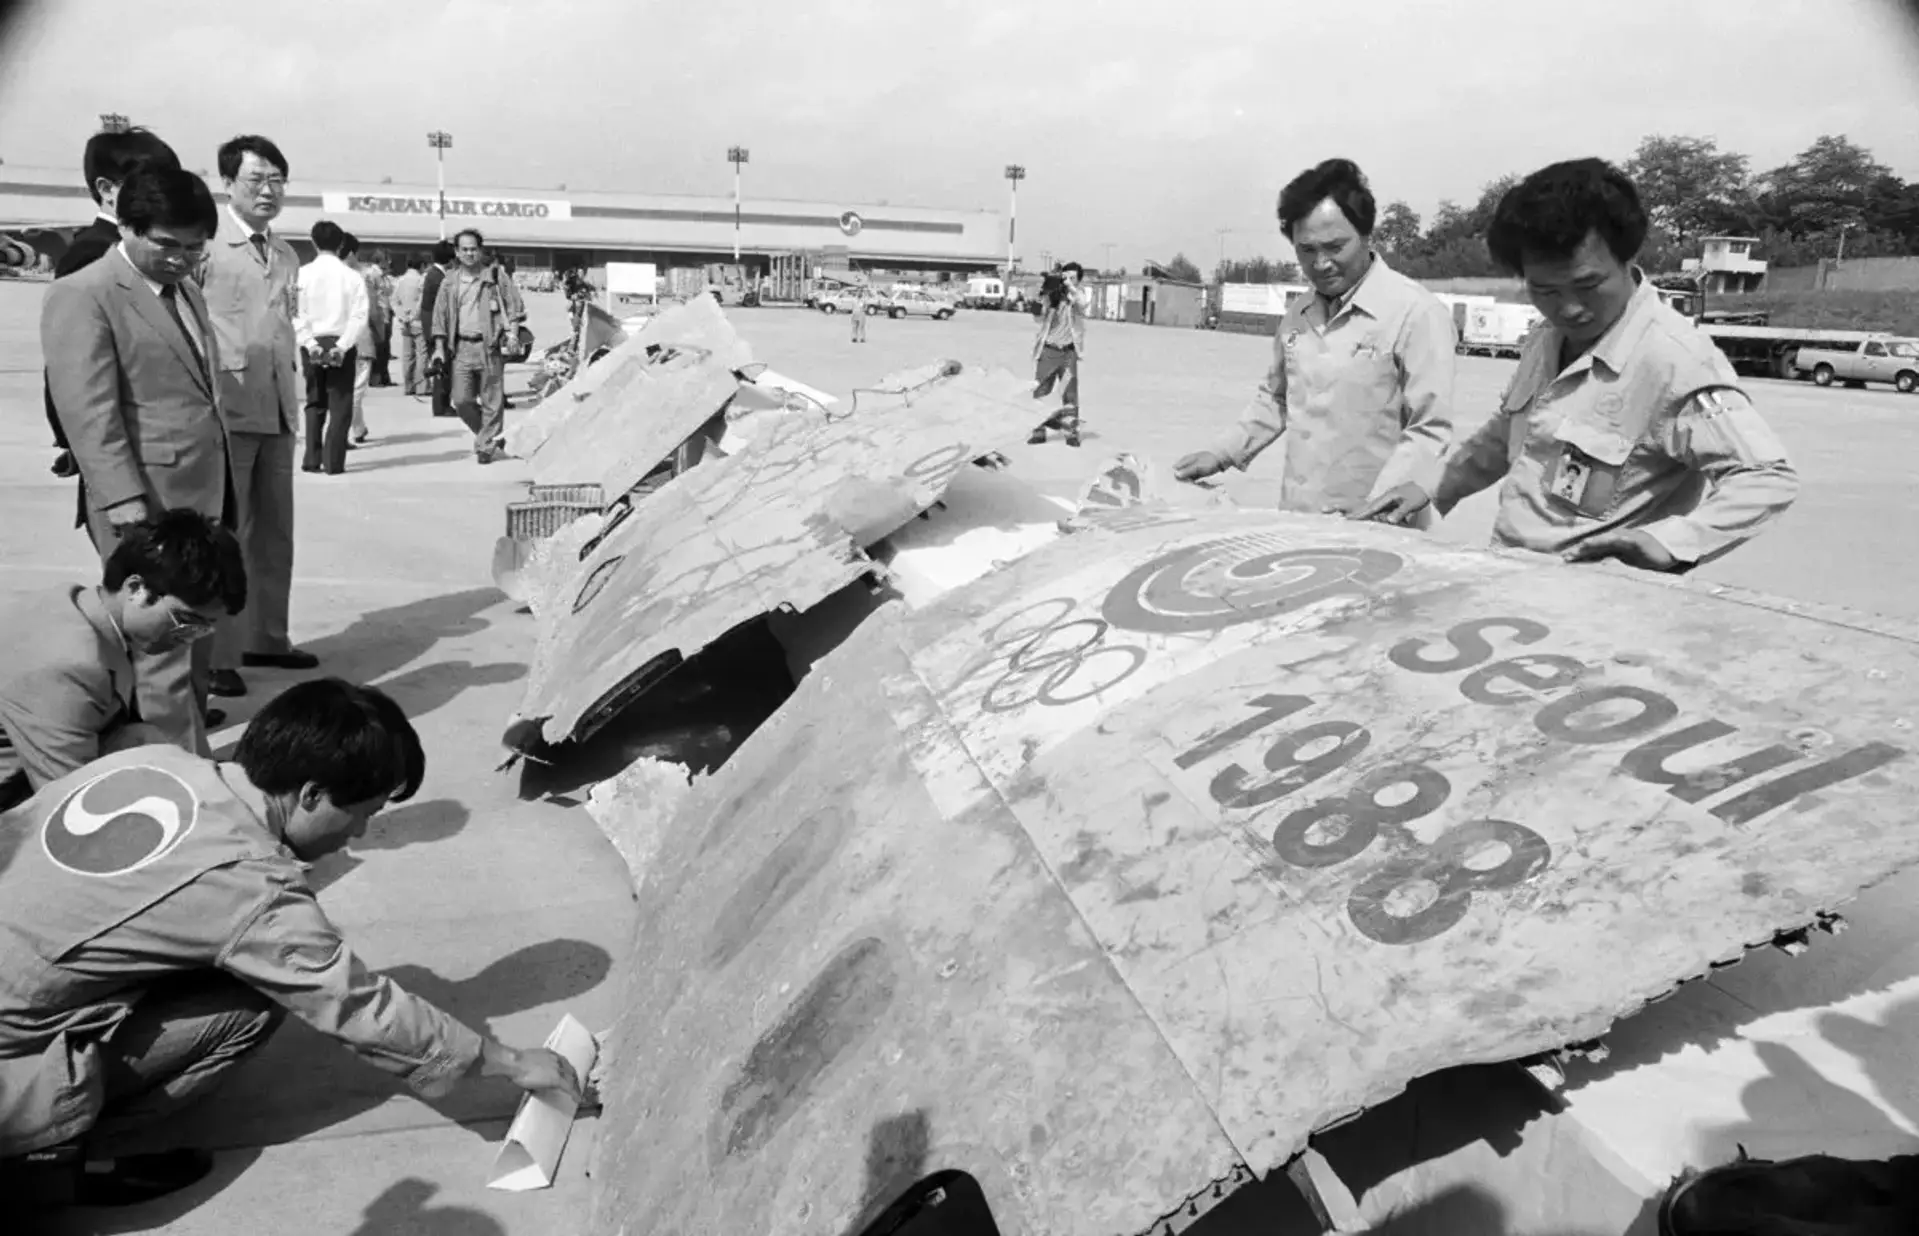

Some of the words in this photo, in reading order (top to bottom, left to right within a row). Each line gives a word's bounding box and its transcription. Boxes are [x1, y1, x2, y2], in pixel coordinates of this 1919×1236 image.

[348, 196, 433, 214] KOREAN
[437, 199, 477, 216] AIR
[480, 201, 549, 218] CARGO
[1173, 693, 1552, 946] 1988
[1388, 617, 1905, 825] Seoul
